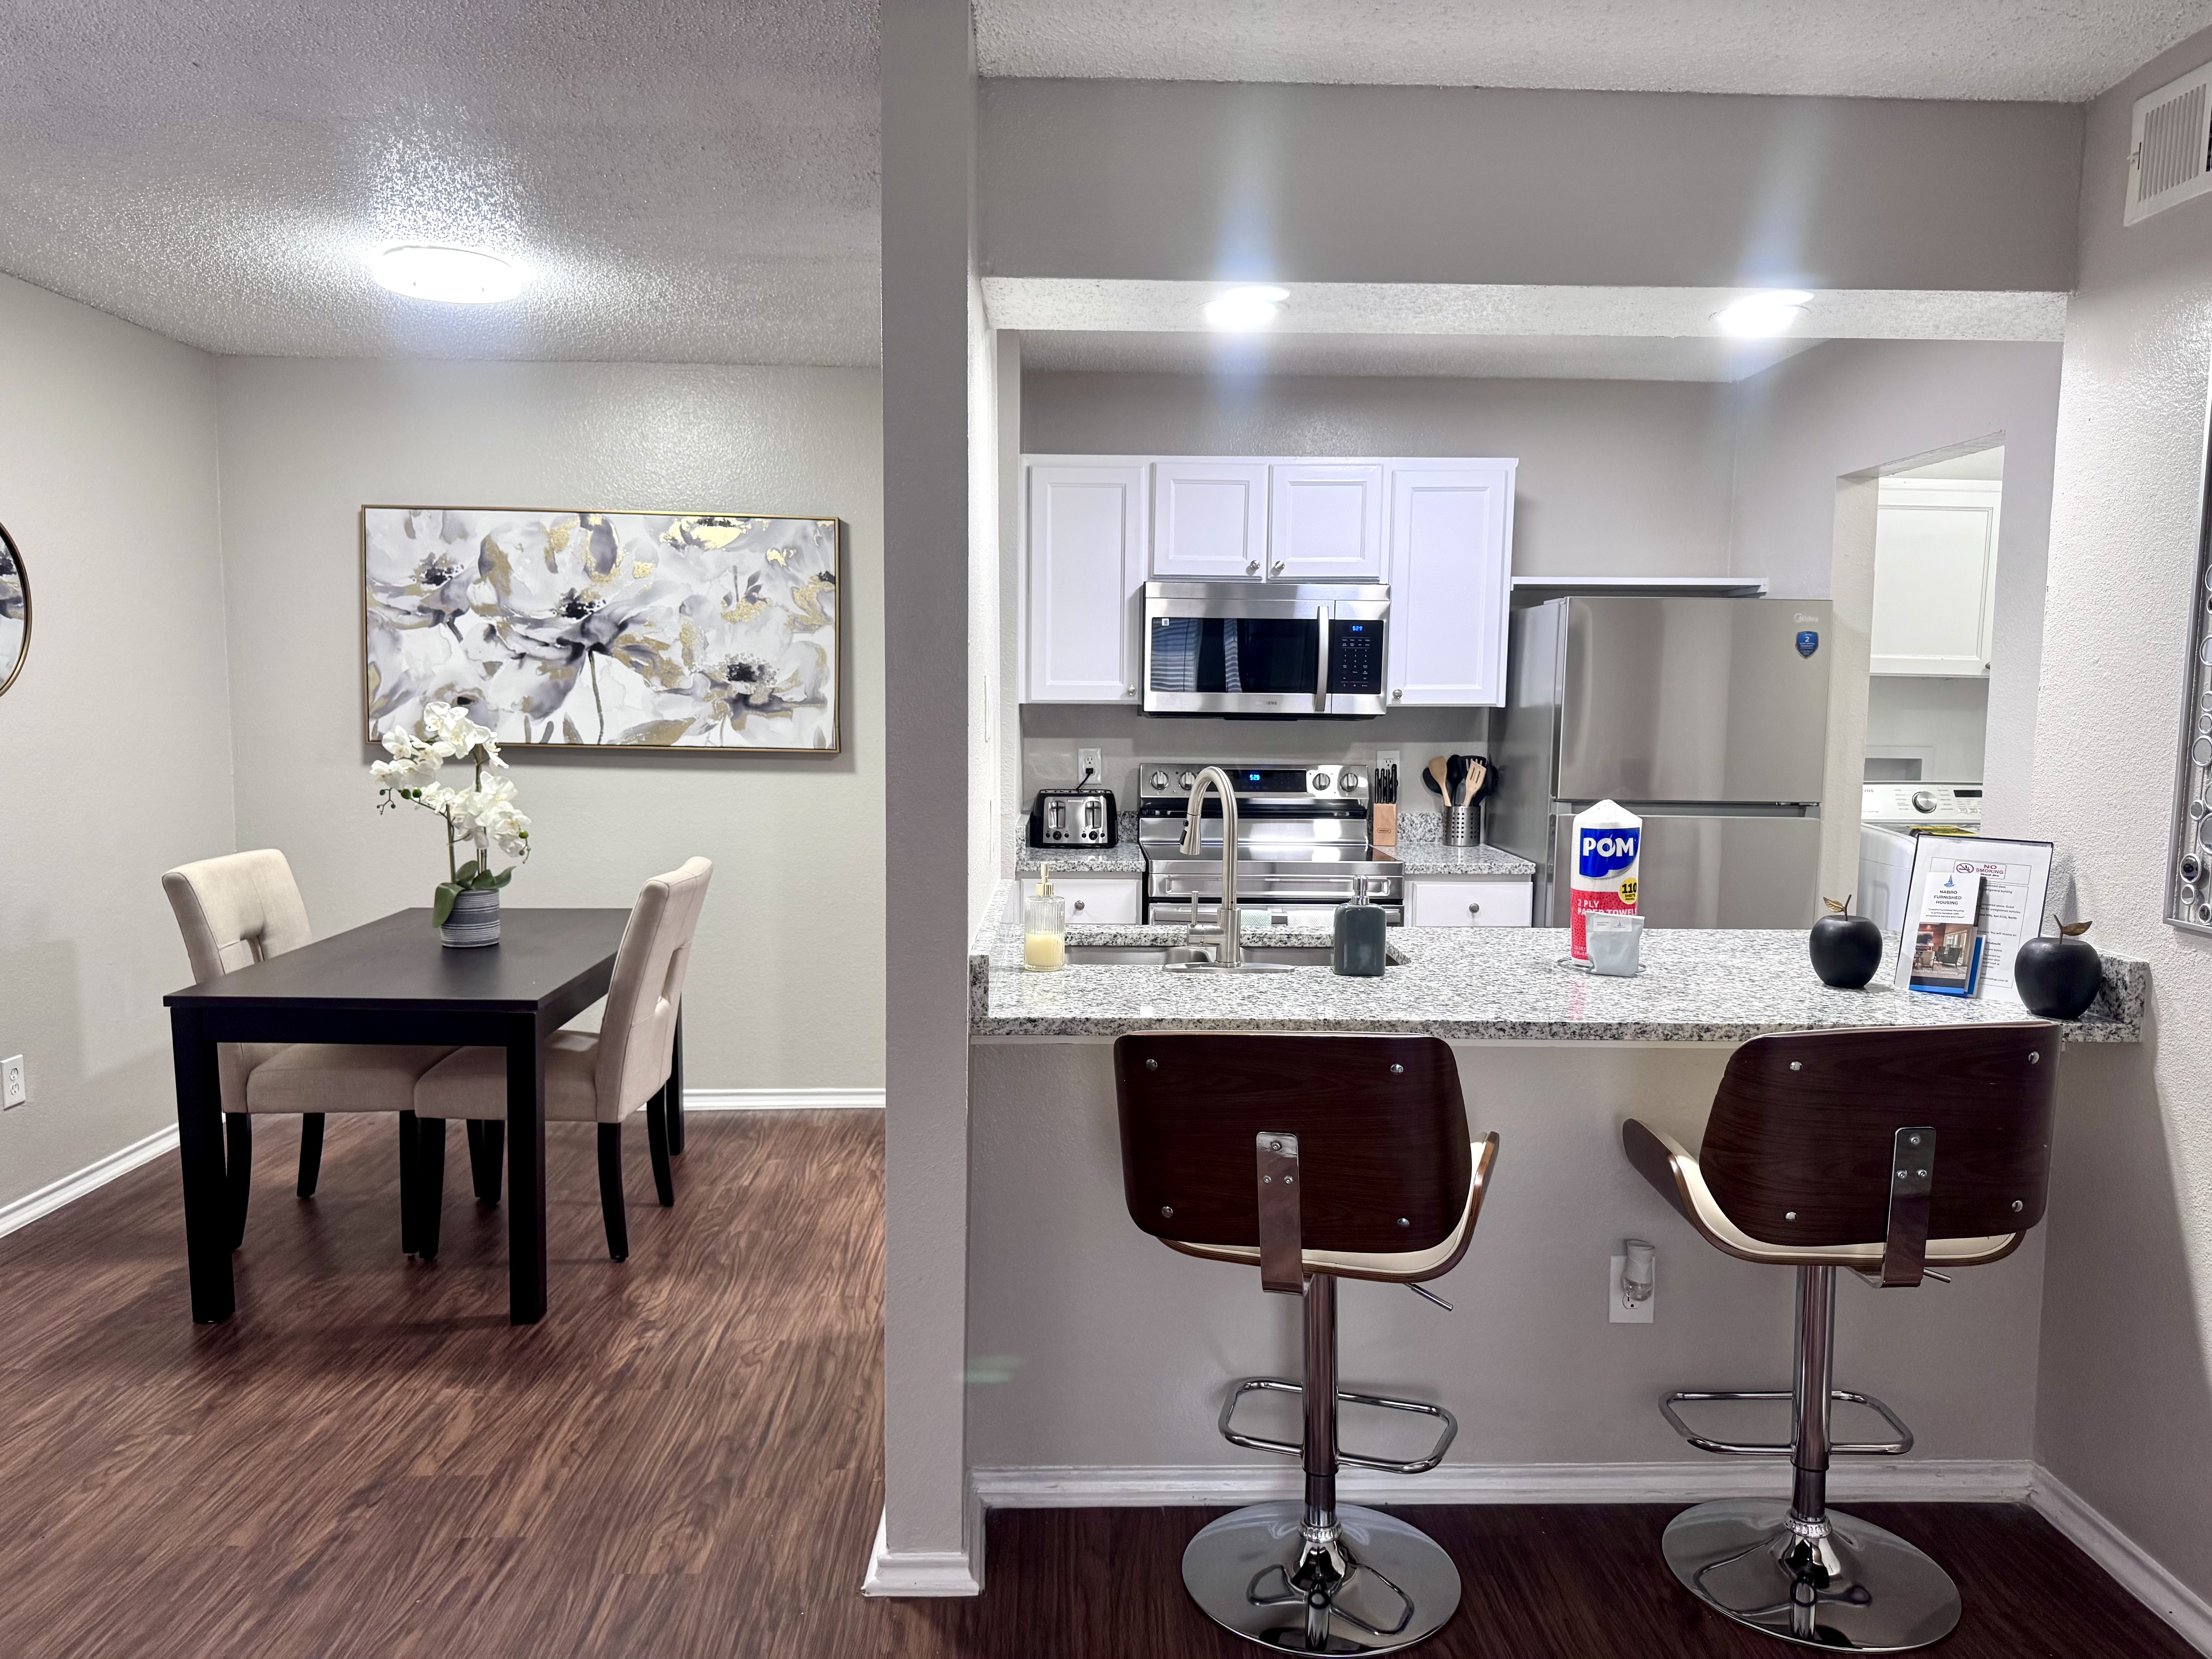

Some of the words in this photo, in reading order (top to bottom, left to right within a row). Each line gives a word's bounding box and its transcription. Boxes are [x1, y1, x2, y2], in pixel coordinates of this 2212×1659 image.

[1794, 613, 1819, 623] Midea
[1583, 837, 1634, 857] POM
[1622, 882, 1637, 893] 110
[1578, 899, 1582, 907] 2
[1584, 900, 1599, 908] PLY
